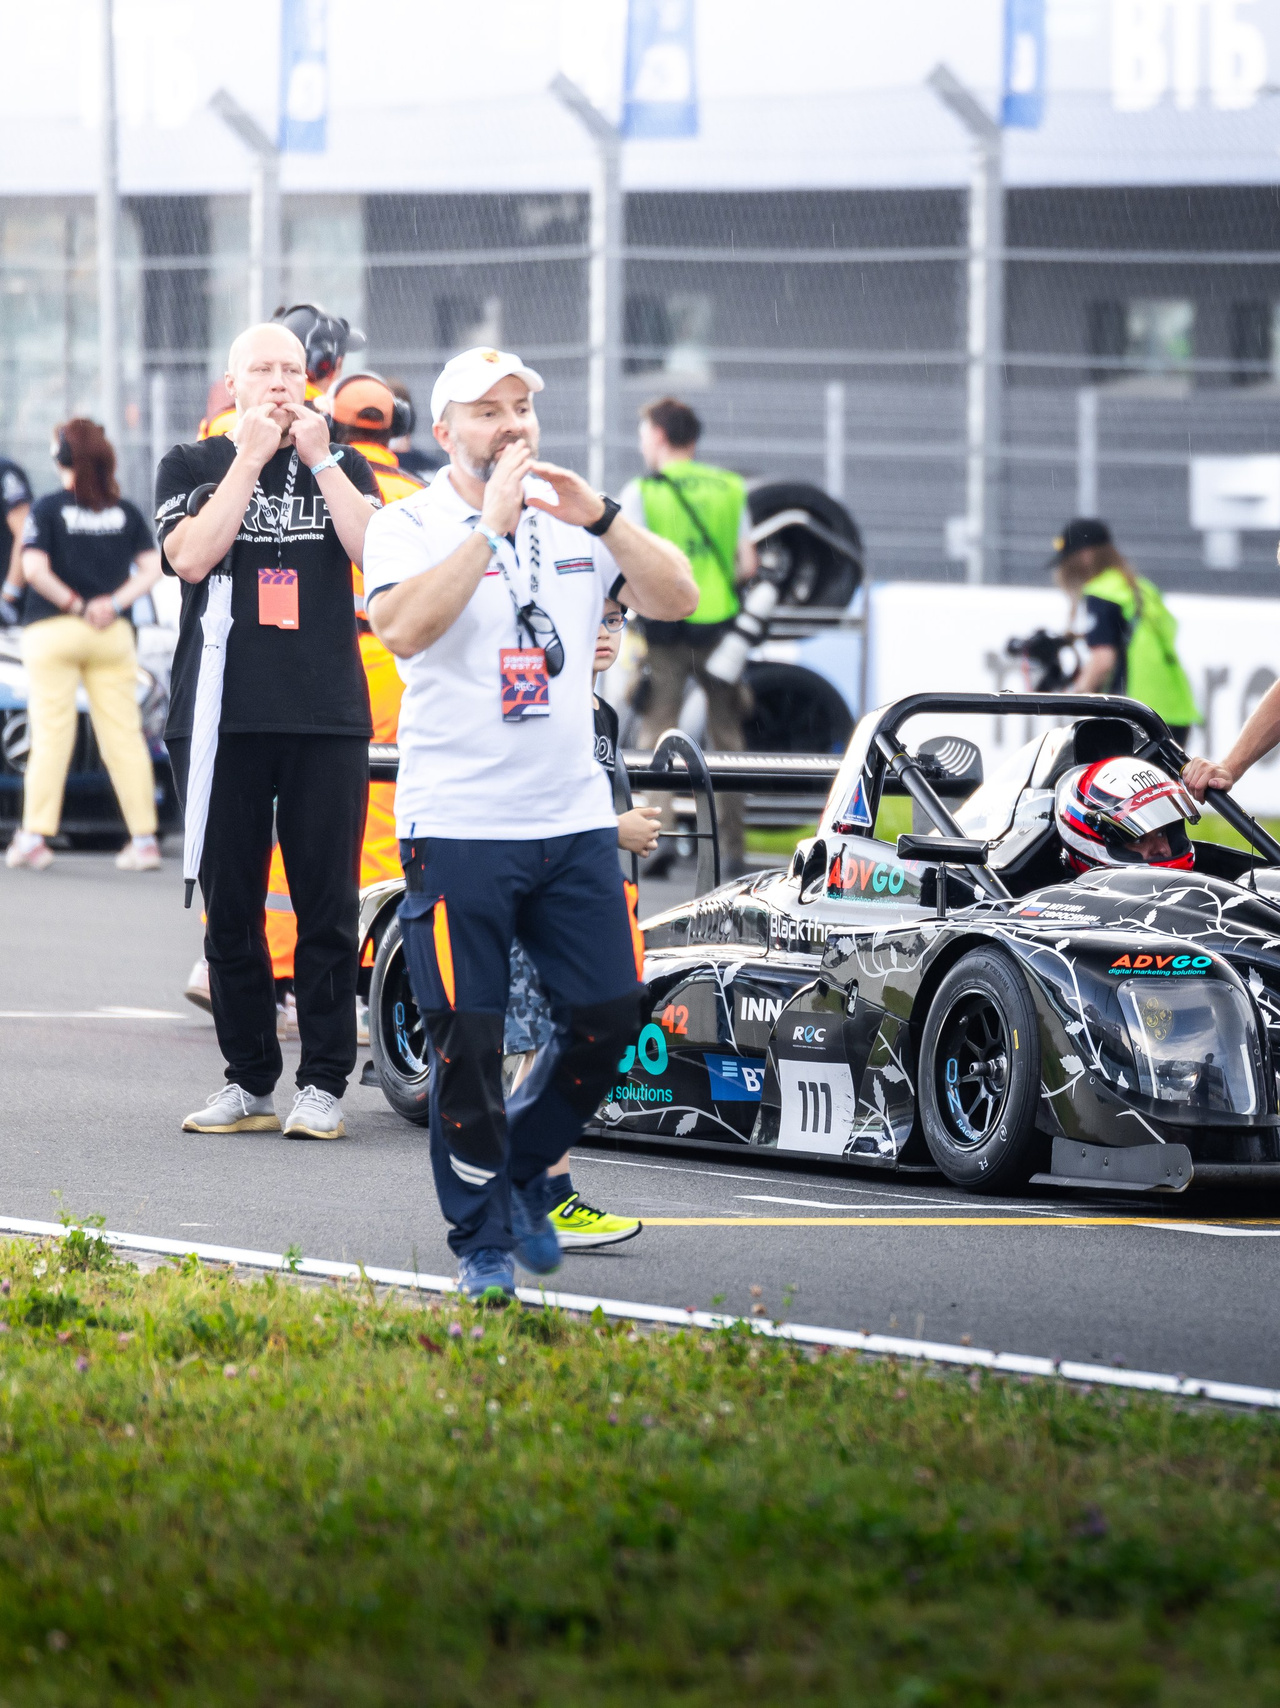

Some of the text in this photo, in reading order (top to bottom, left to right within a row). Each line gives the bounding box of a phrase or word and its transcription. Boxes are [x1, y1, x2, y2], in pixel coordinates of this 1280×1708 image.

[235, 532, 253, 543] alität
[254, 534, 273, 543] ohne
[827, 856, 905, 894] ADVGO
[1046, 902, 1086, 913] МУХИН
[770, 913, 842, 942] Blacktho
[1108, 968, 1206, 977] digital marketing solutions
[1111, 954, 1213, 969] ADVGO
[661, 1004, 689, 1035] 42
[740, 997, 785, 1022] INN
[615, 1083, 673, 1102] solutions
[798, 1080, 833, 1134] 111
